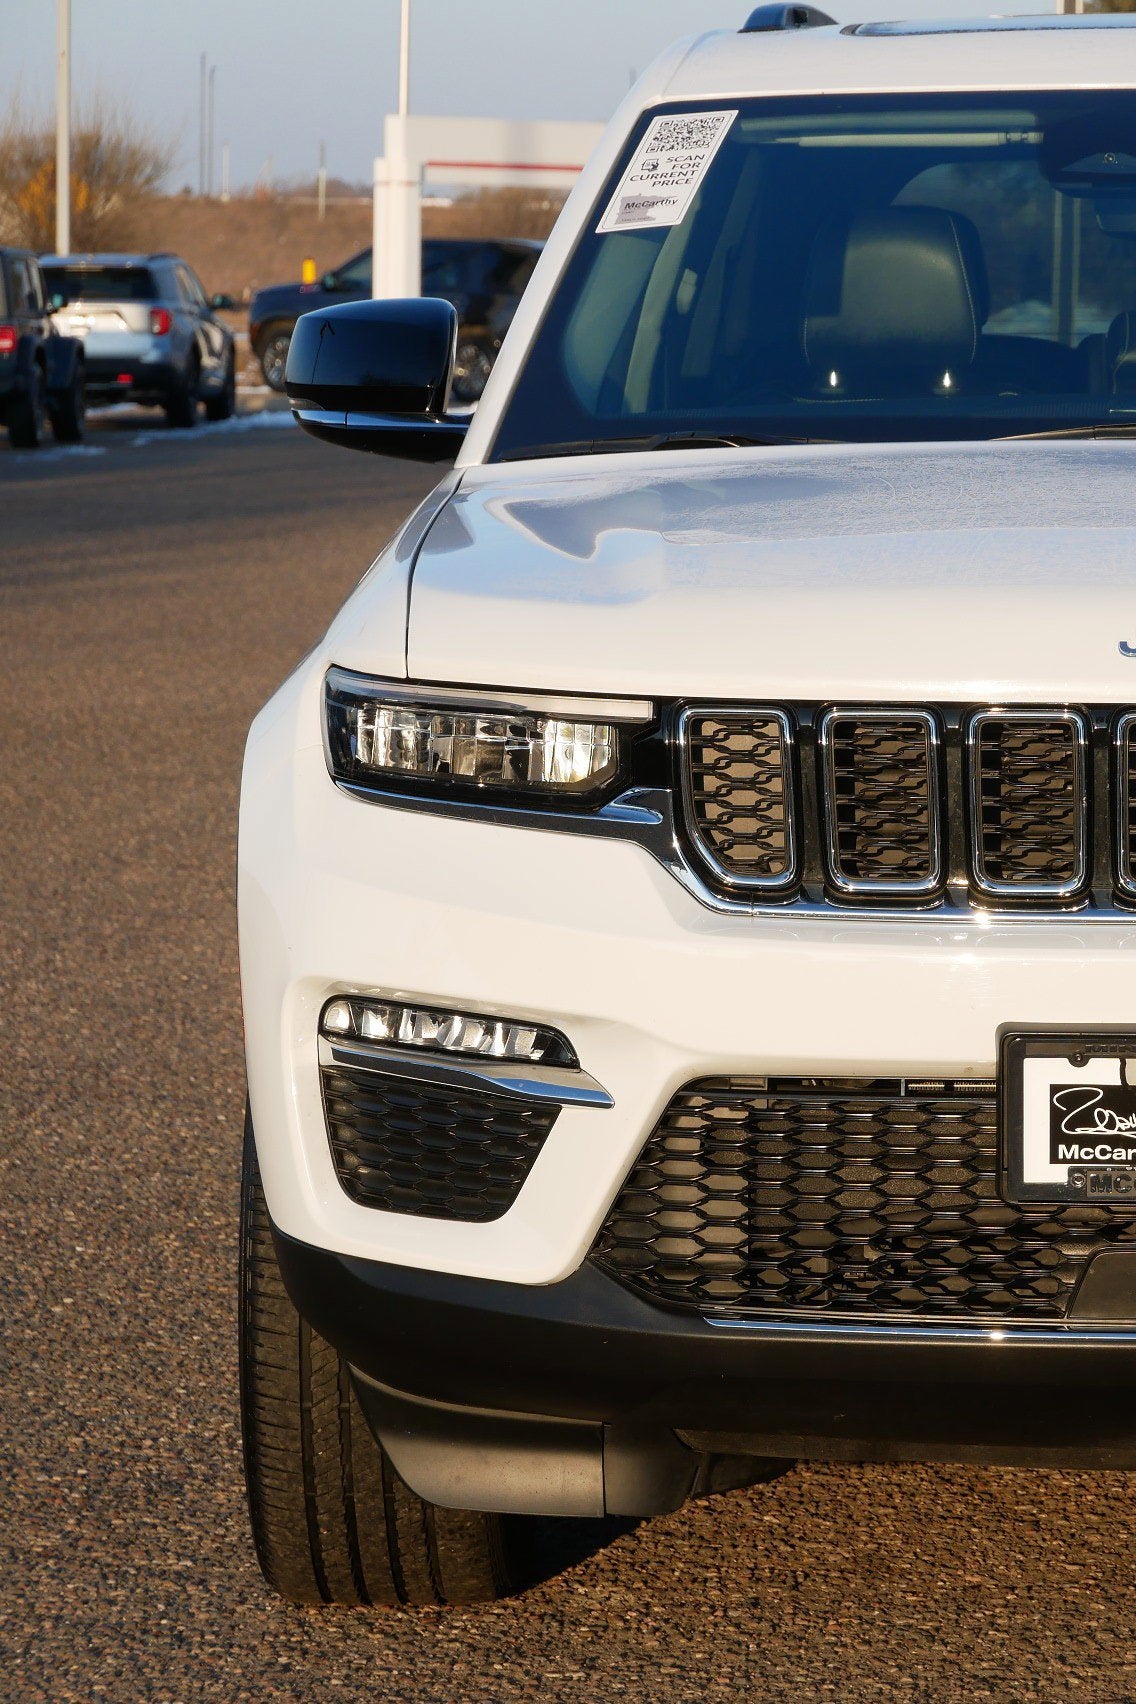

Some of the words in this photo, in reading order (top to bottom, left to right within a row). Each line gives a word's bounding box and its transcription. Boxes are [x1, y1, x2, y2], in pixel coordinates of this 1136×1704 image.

[666, 154, 705, 163] SCAN
[671, 162, 701, 170] FOR
[630, 170, 698, 181] CURRENT
[652, 178, 694, 187] PRICE
[624, 198, 679, 210] McCarthy
